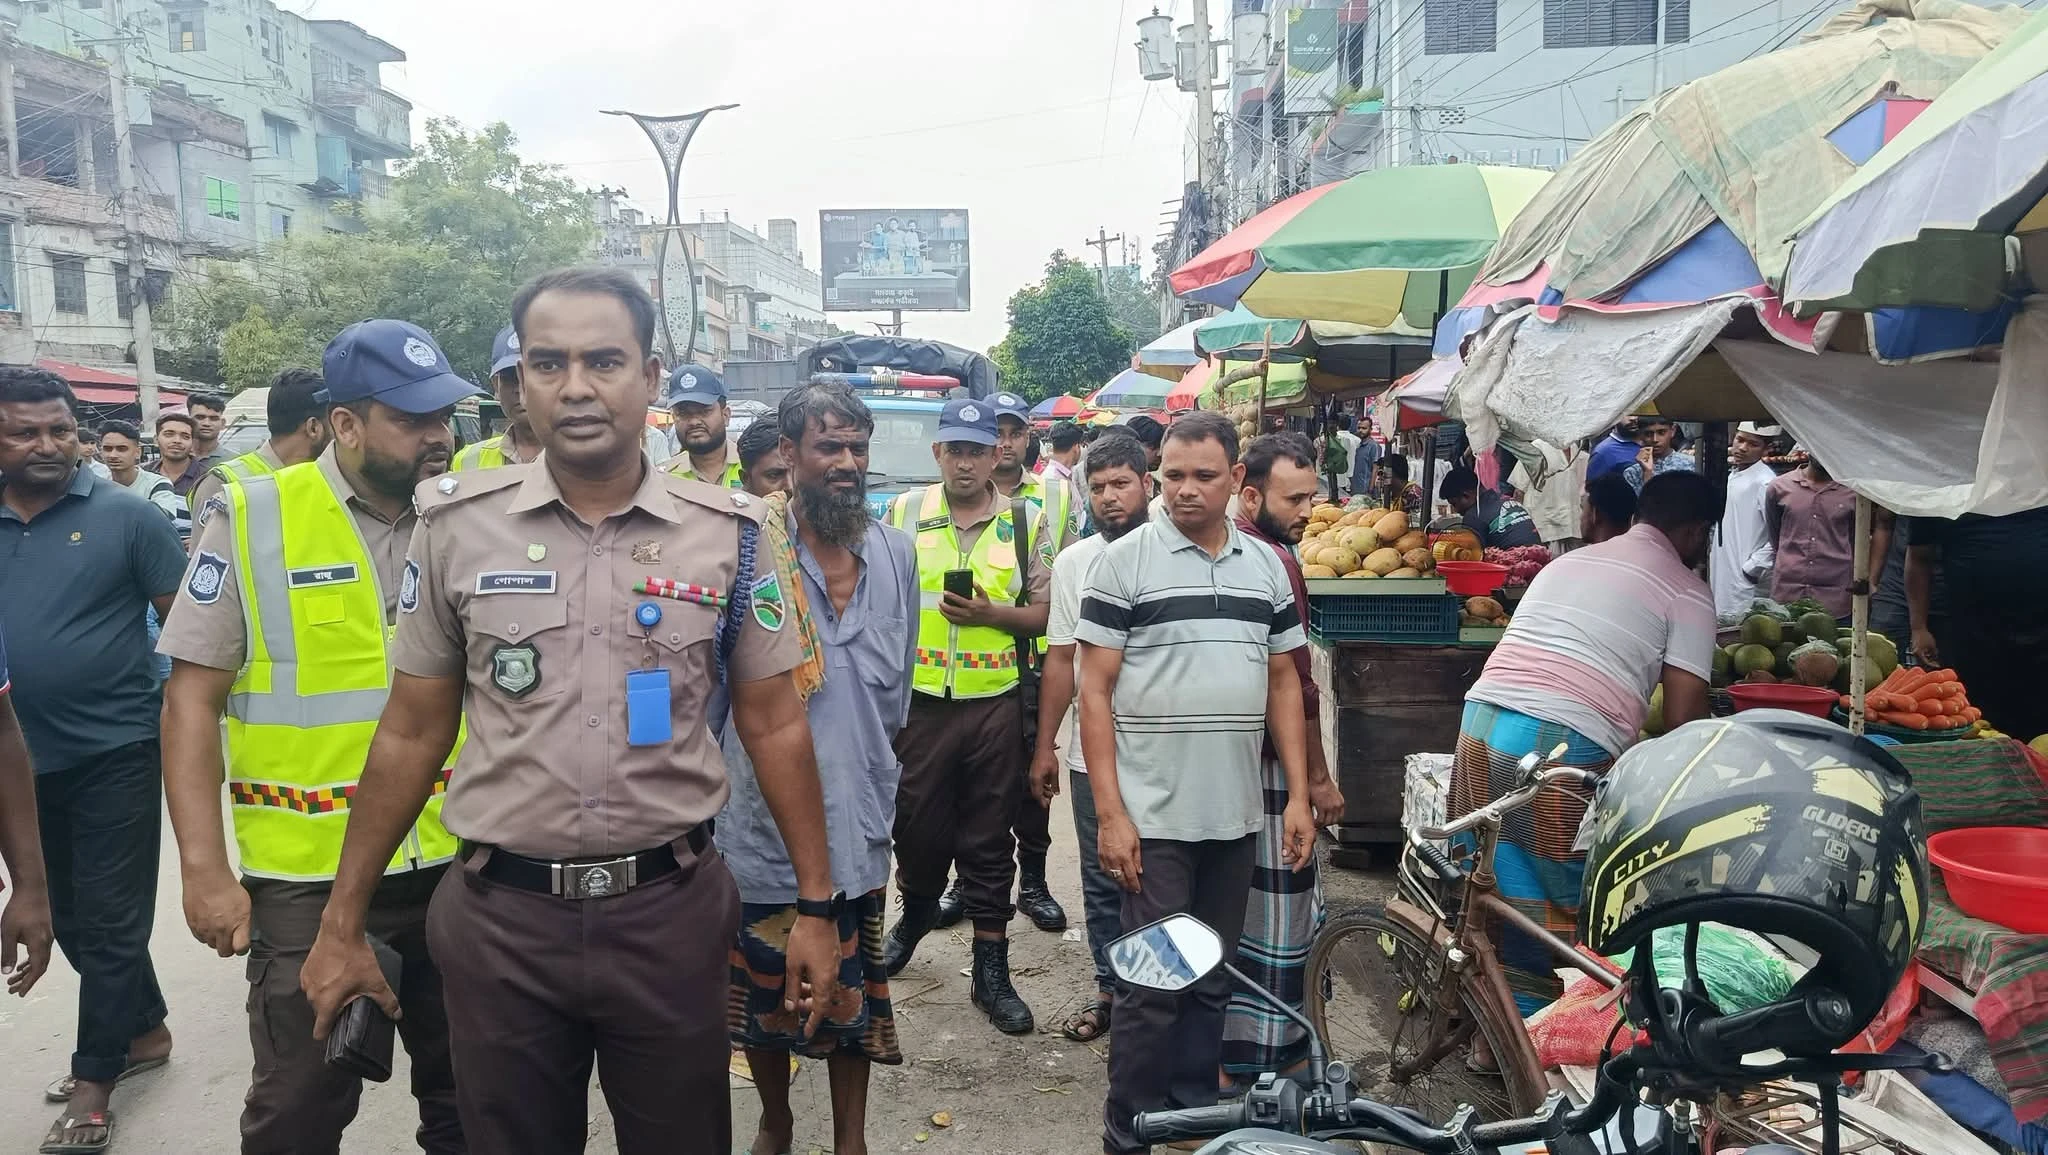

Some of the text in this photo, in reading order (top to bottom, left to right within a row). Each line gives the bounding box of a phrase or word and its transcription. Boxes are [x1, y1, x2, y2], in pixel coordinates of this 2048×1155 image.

[494, 576, 535, 585] গোপাল
[1802, 805, 1881, 844] GLIDERS
[1614, 839, 1670, 885] CITY
